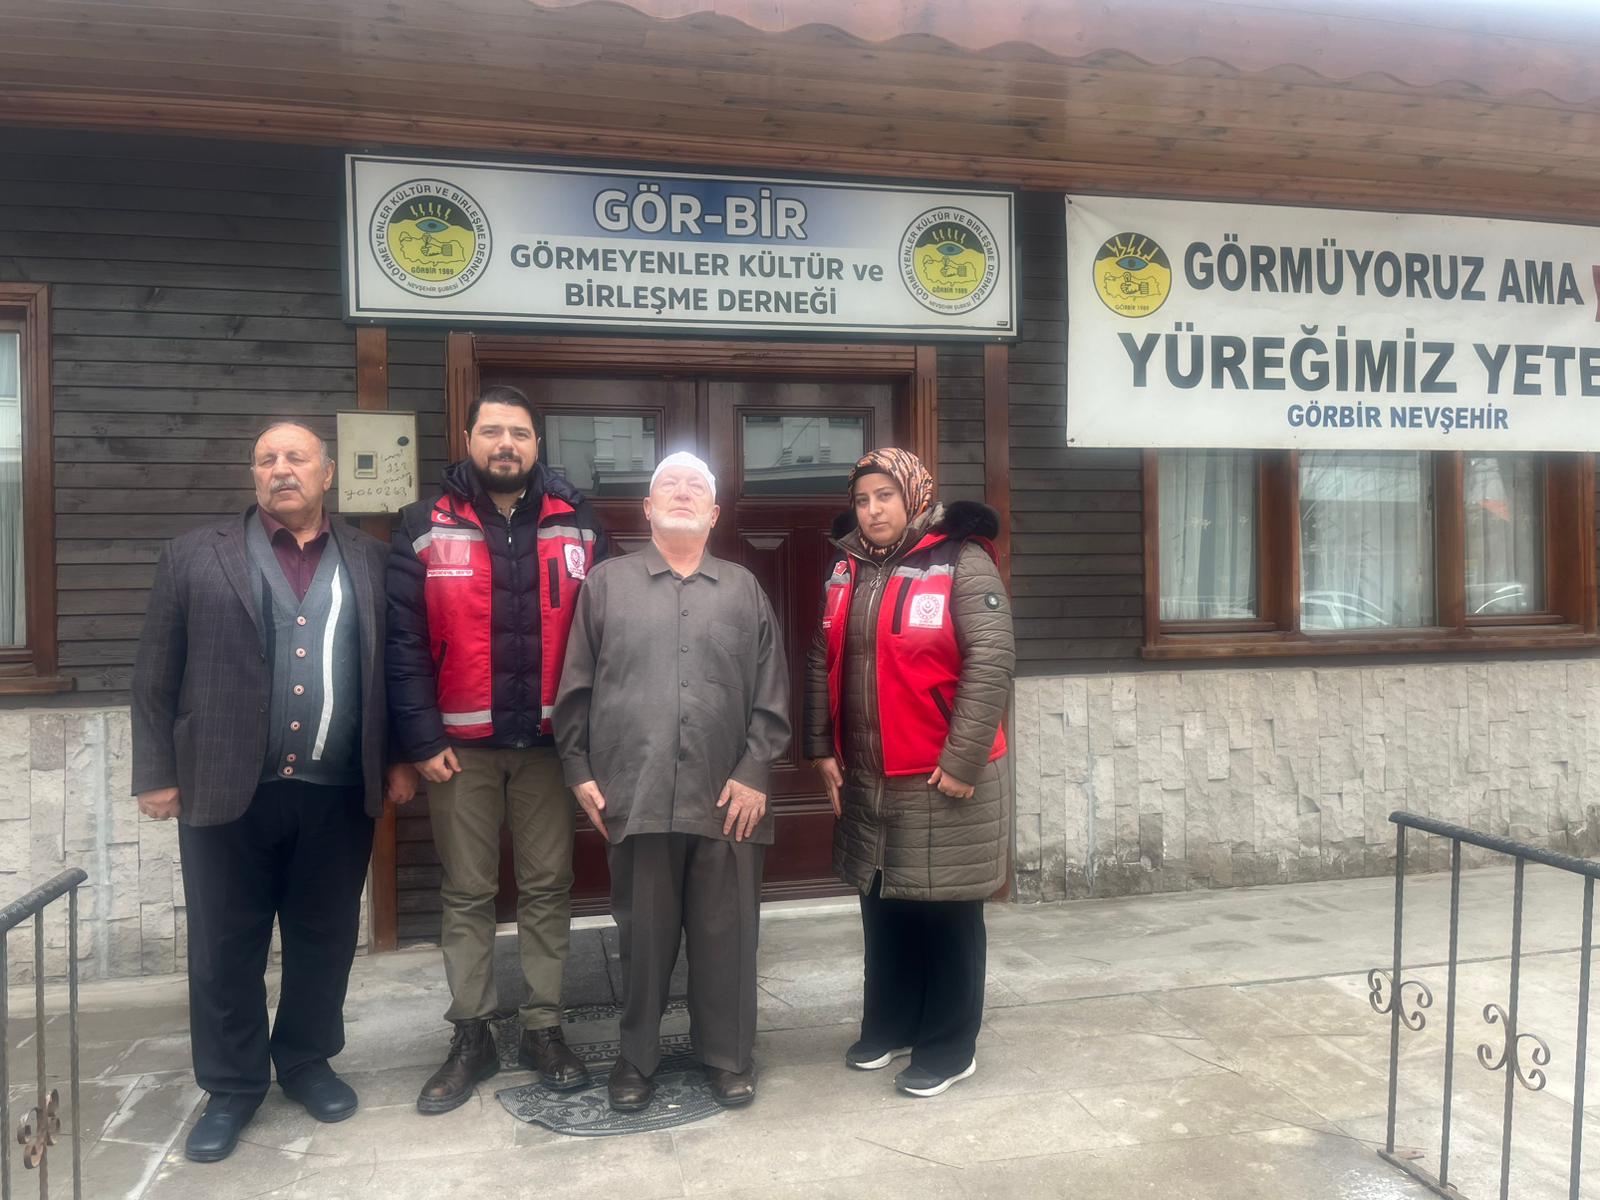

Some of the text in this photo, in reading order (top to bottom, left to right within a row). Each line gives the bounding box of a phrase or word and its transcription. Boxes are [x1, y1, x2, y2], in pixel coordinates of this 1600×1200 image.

[376, 184, 486, 287] GÖRMEYENLER KÜLTÜR VE BİRLEŞME DERNEĞİ
[594, 183, 807, 240] GÖR-BİR
[916, 211, 950, 232] KÜLTÜR
[953, 213, 965, 223] VE
[510, 240, 884, 282] GÖRMEYENLER KÜLTÜR ve
[904, 231, 929, 300] GÖRMEYENLER
[1184, 233, 1486, 302] GÖRMÜYORUZ
[1498, 258, 1585, 305] AMA
[565, 278, 837, 315] BİRLEŞME DERNEĞİ
[1117, 321, 1458, 394] YÜREĞİMİZ
[1287, 400, 1509, 434] GÖRBİR NEVŞEHİR
